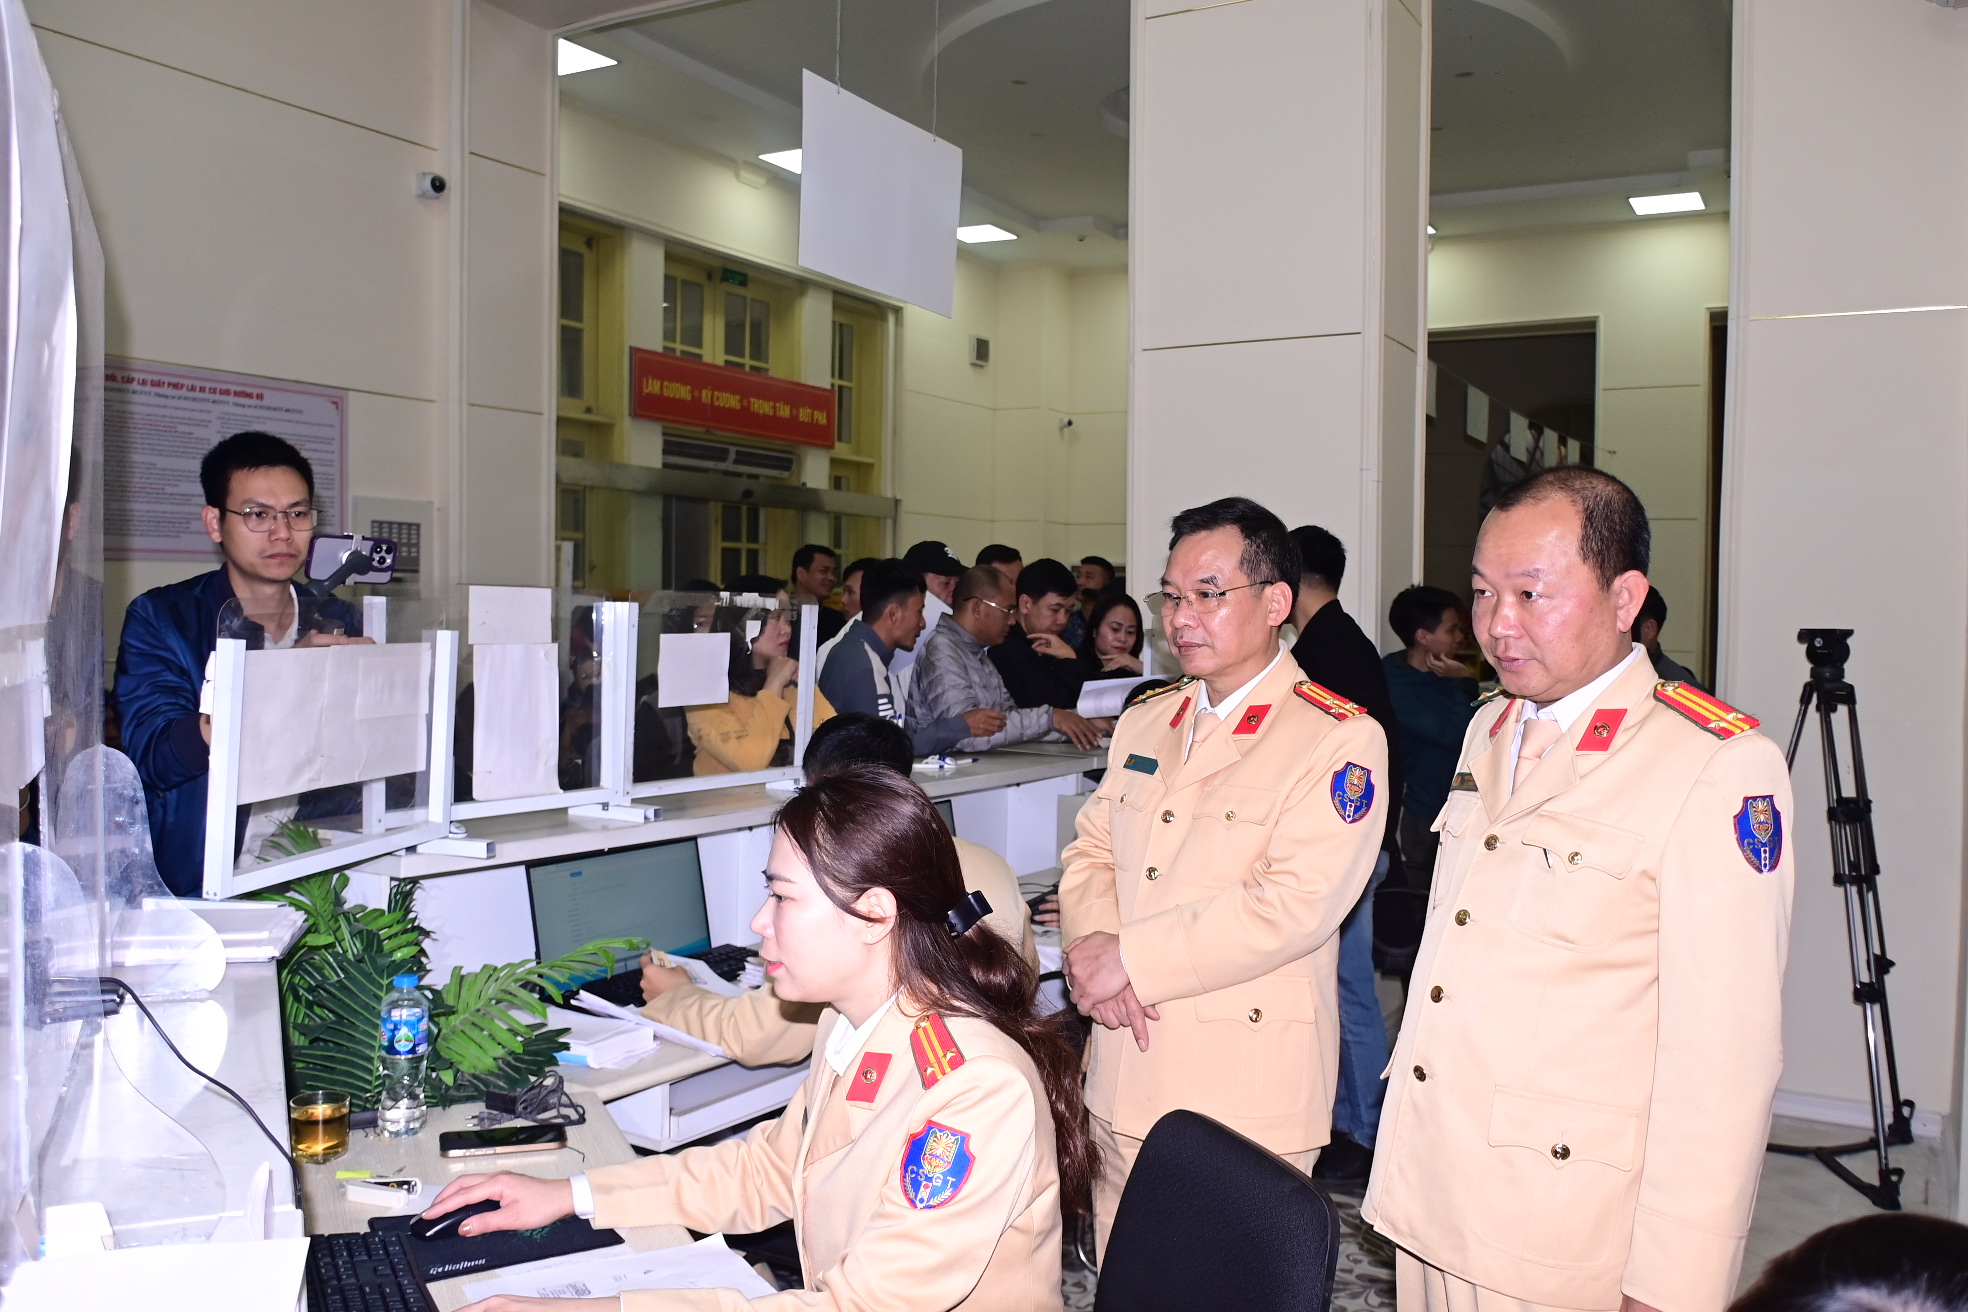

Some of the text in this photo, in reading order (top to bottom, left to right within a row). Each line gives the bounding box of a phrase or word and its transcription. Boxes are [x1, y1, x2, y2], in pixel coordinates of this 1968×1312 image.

[643, 375, 661, 395] LÀM
[663, 381, 692, 401] GƯƠNG
[714, 390, 741, 410] CƯƠNG
[750, 397, 775, 417] TRỌNG
[775, 401, 790, 419] TÂM
[813, 409, 827, 425] PHÁ
[1335, 791, 1368, 808] CSGT
[907, 1165, 956, 1188] CSGT
